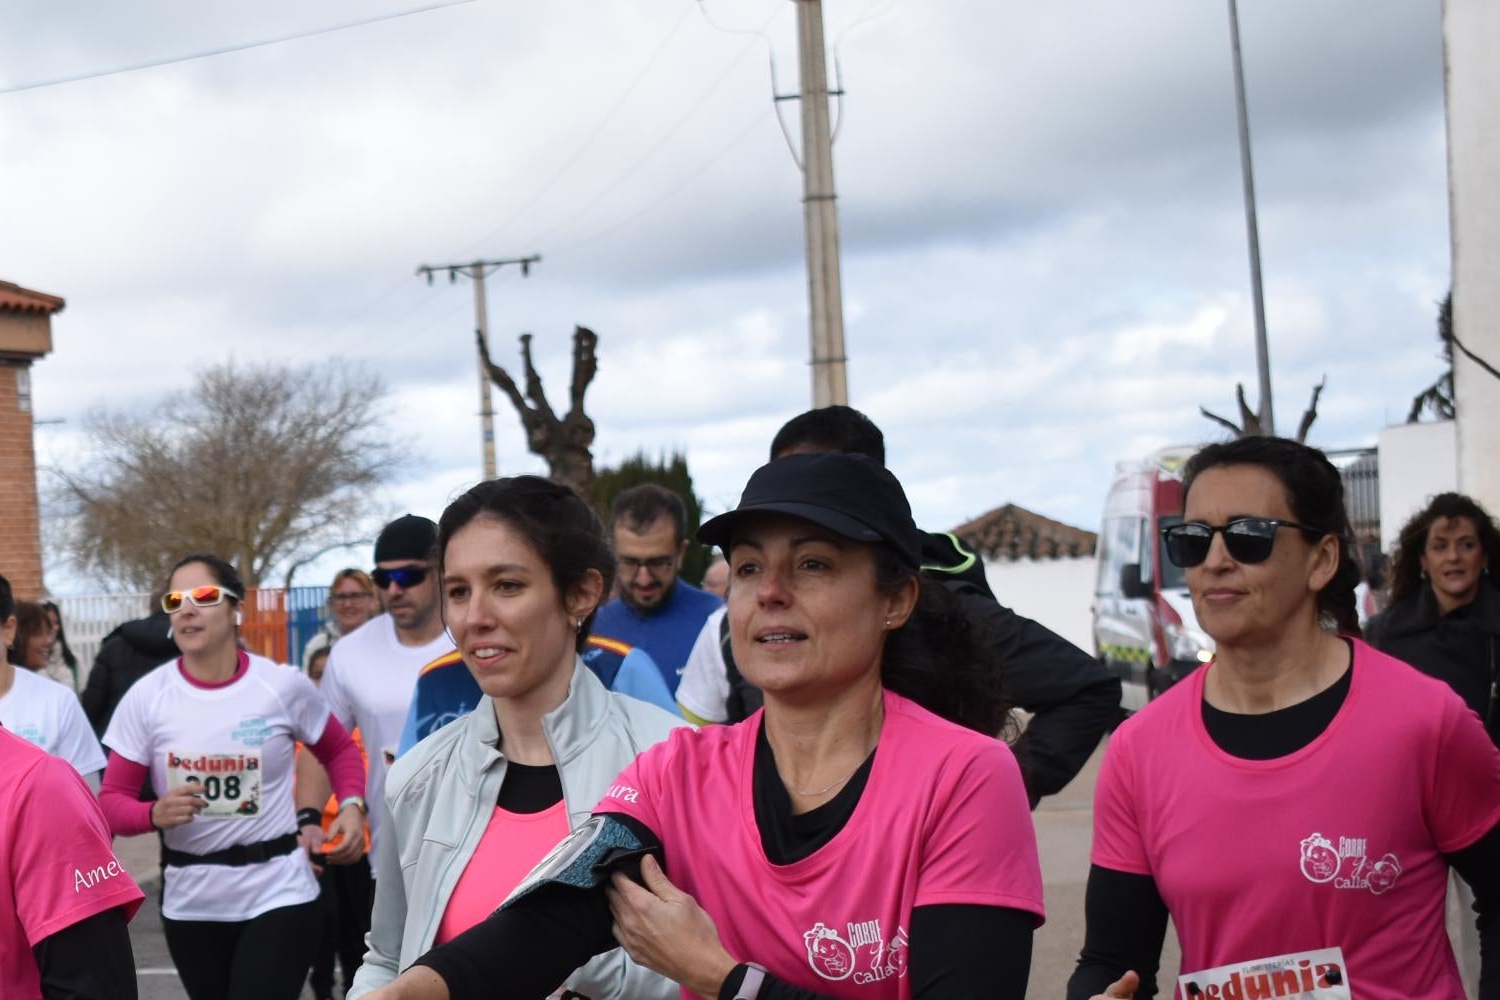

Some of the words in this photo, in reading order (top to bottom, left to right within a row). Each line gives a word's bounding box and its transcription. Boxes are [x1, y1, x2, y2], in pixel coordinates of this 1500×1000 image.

[167, 752, 258, 772] bedunia
[1334, 876, 1368, 889] Calla
[853, 966, 894, 985] Calla
